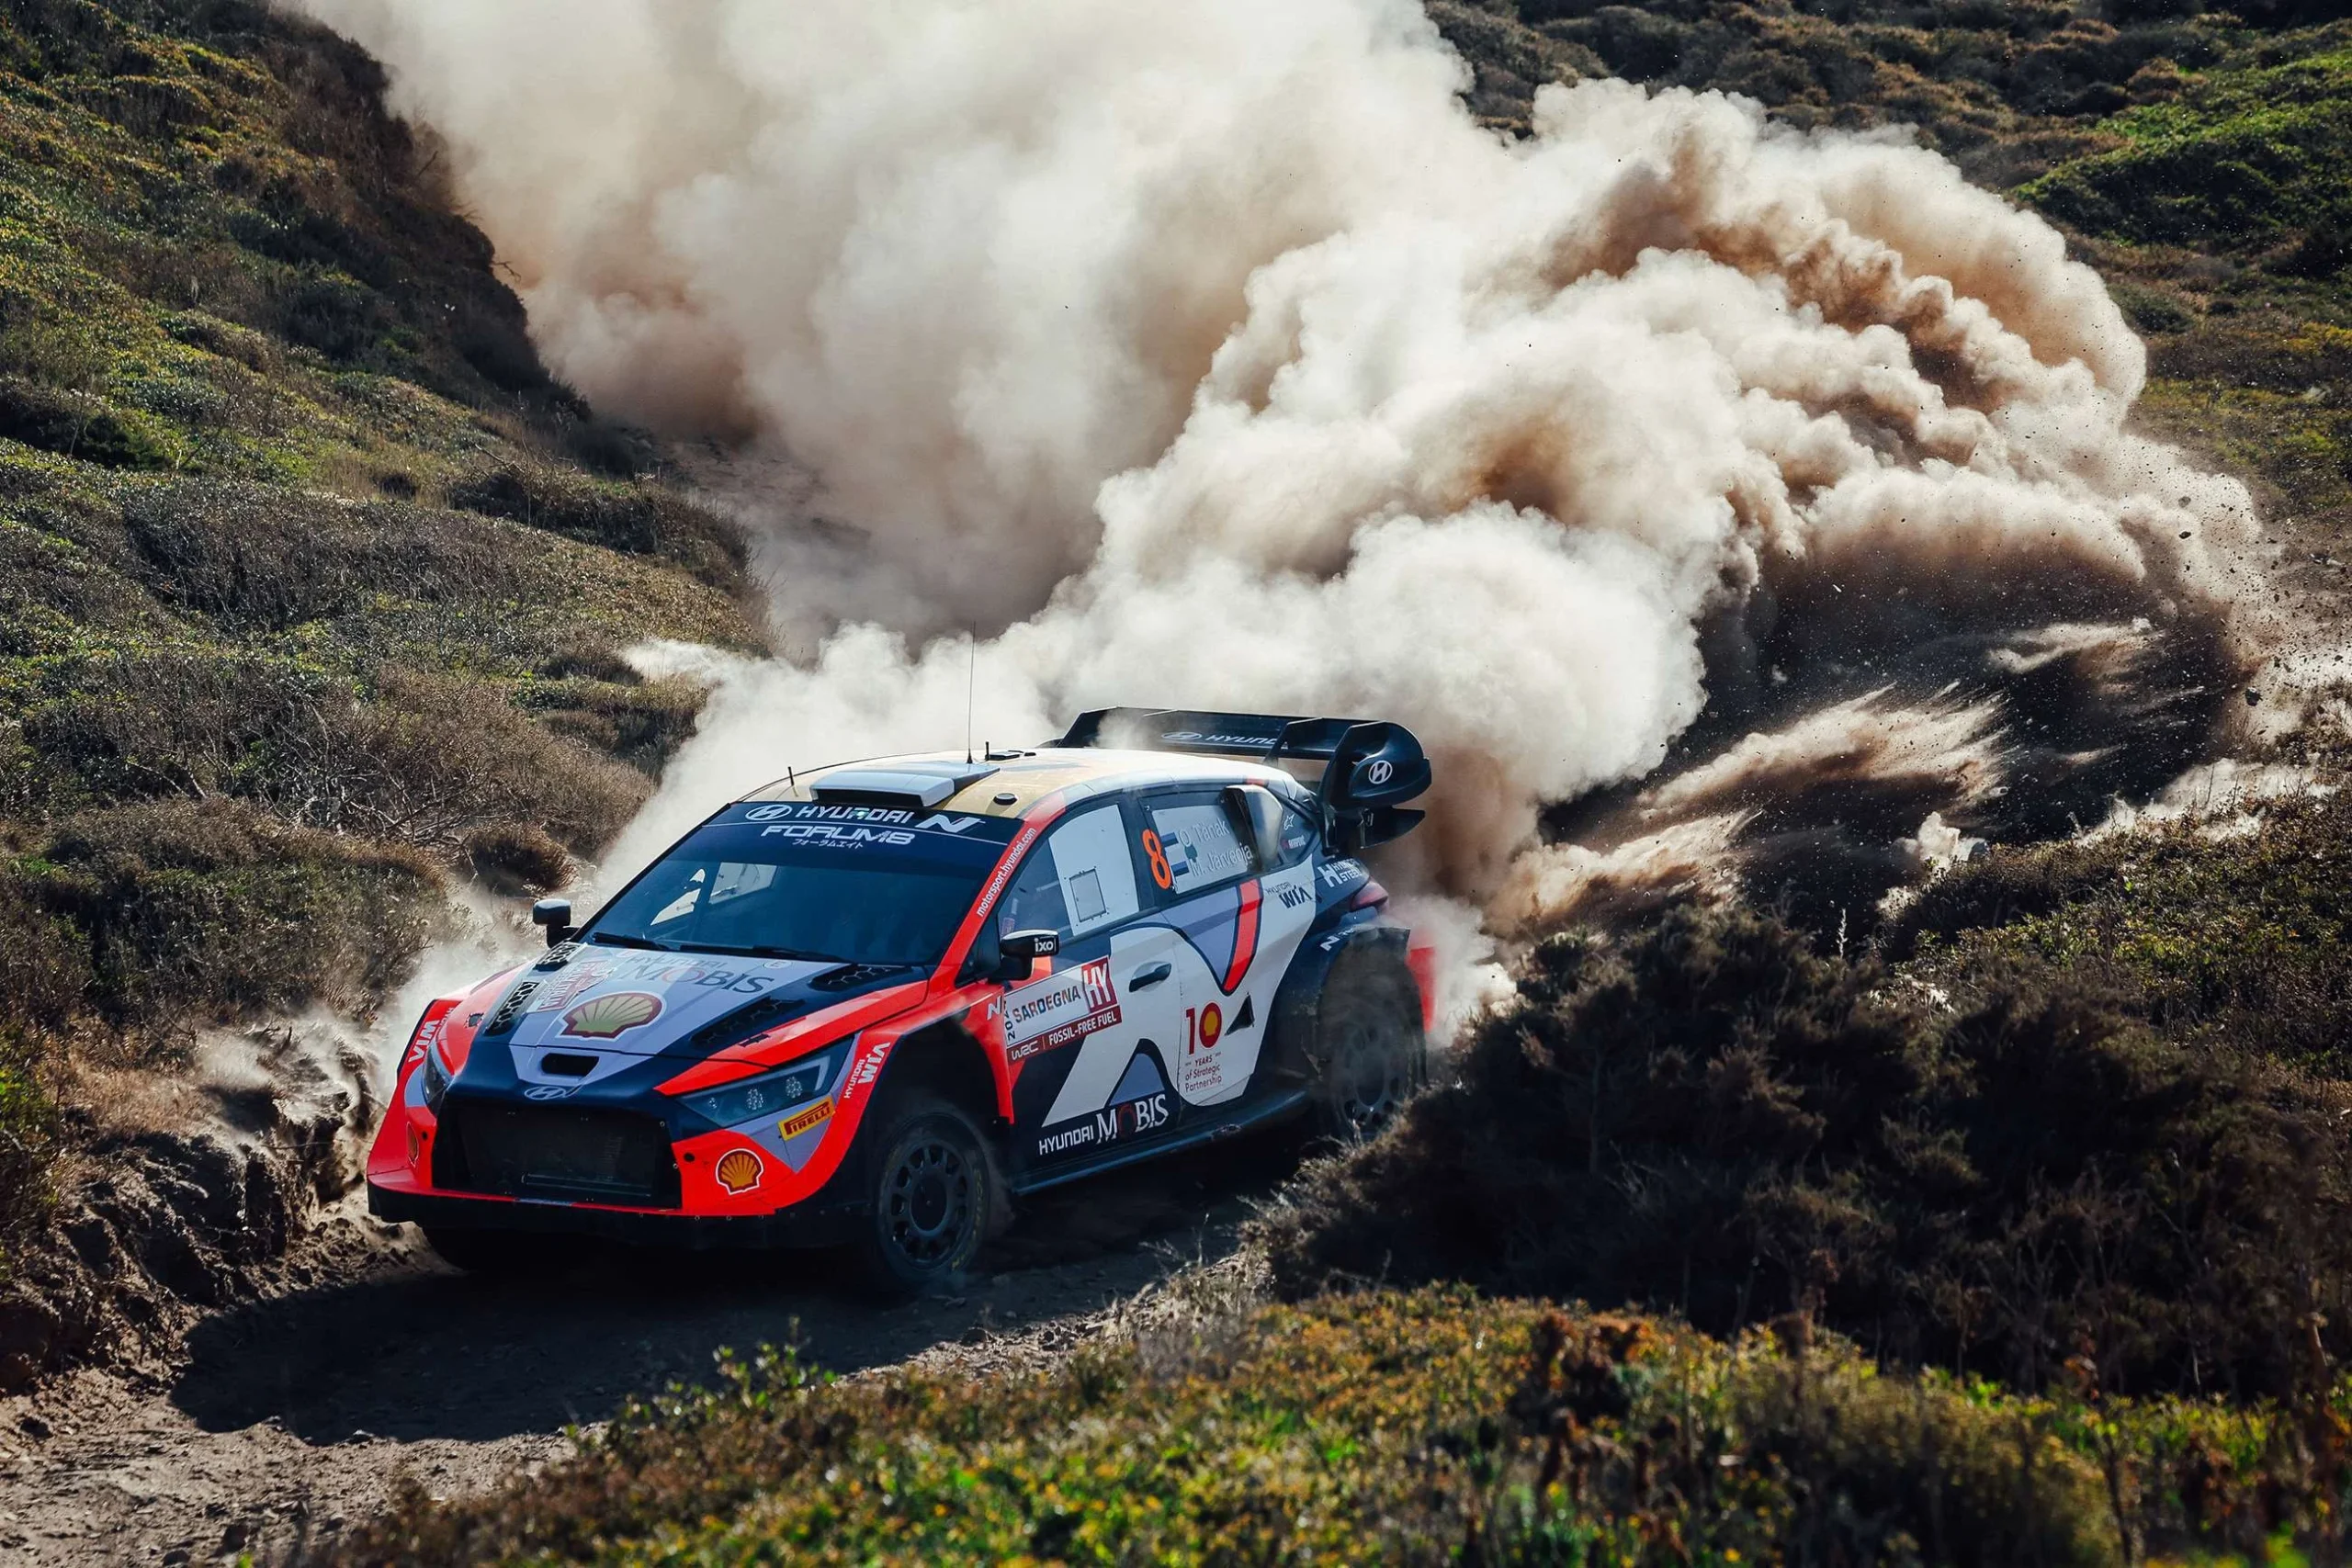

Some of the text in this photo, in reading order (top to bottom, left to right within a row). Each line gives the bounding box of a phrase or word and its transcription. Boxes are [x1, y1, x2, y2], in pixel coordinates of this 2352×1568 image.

[795, 806, 914, 824] HYUNDAI
[761, 825, 916, 845] FORUM8
[793, 838, 864, 849] フォーラムエイト
[977, 827, 1036, 917] motorsport.hyundai.com
[1142, 829, 1172, 889] 8
[1265, 882, 1292, 895] HYUNDAI
[1034, 938, 1054, 953] ixo
[619, 964, 775, 993] MOBIS
[1083, 963, 1112, 1009] HY
[1012, 986, 1081, 1023] SARDEGNA
[1011, 1010, 1117, 1061] WRC FOSSIL-FREE FUEL
[1185, 1001, 1223, 1055] 10
[1185, 1062, 1221, 1081] of Strategic
[1195, 1055, 1213, 1066] YEARS
[843, 1059, 865, 1099] HYUNDAI
[1185, 1074, 1223, 1092] Partnership
[784, 1101, 831, 1135] PIRELLI
[1038, 1094, 1170, 1156] HYUNDAI MOBIS
